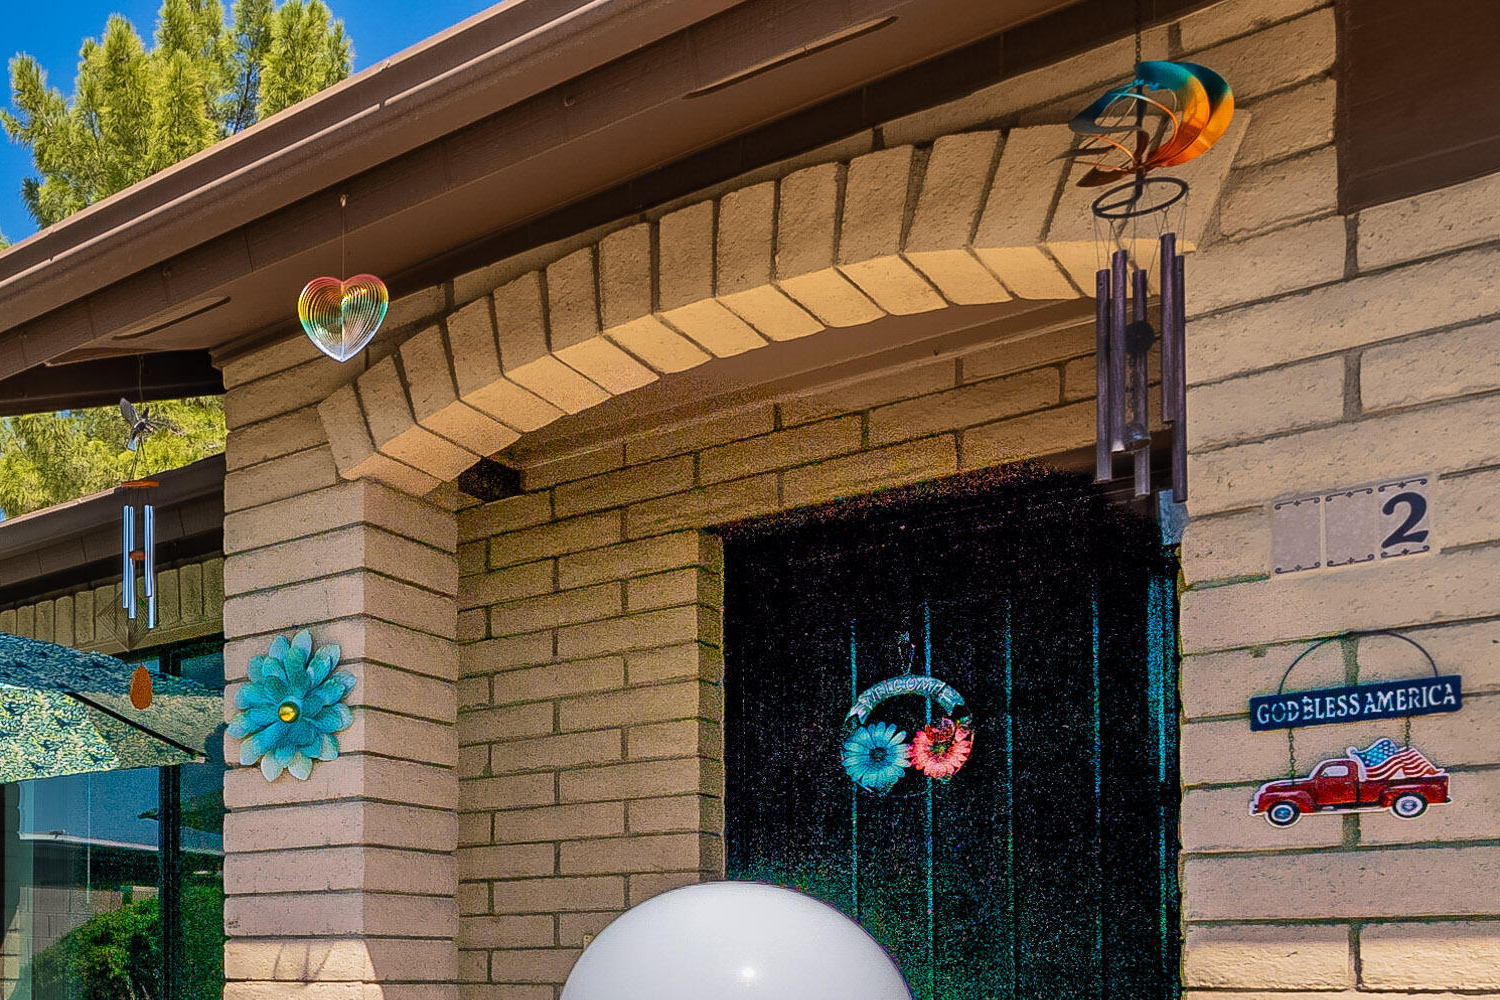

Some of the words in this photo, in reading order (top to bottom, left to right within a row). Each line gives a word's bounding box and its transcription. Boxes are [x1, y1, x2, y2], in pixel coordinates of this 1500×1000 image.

[1381, 491, 1429, 548] 2
[863, 677, 958, 710] WELCOME
[1257, 703, 1299, 725] GOD
[1301, 695, 1360, 720] BLESS
[1364, 682, 1456, 714] AMERICA
